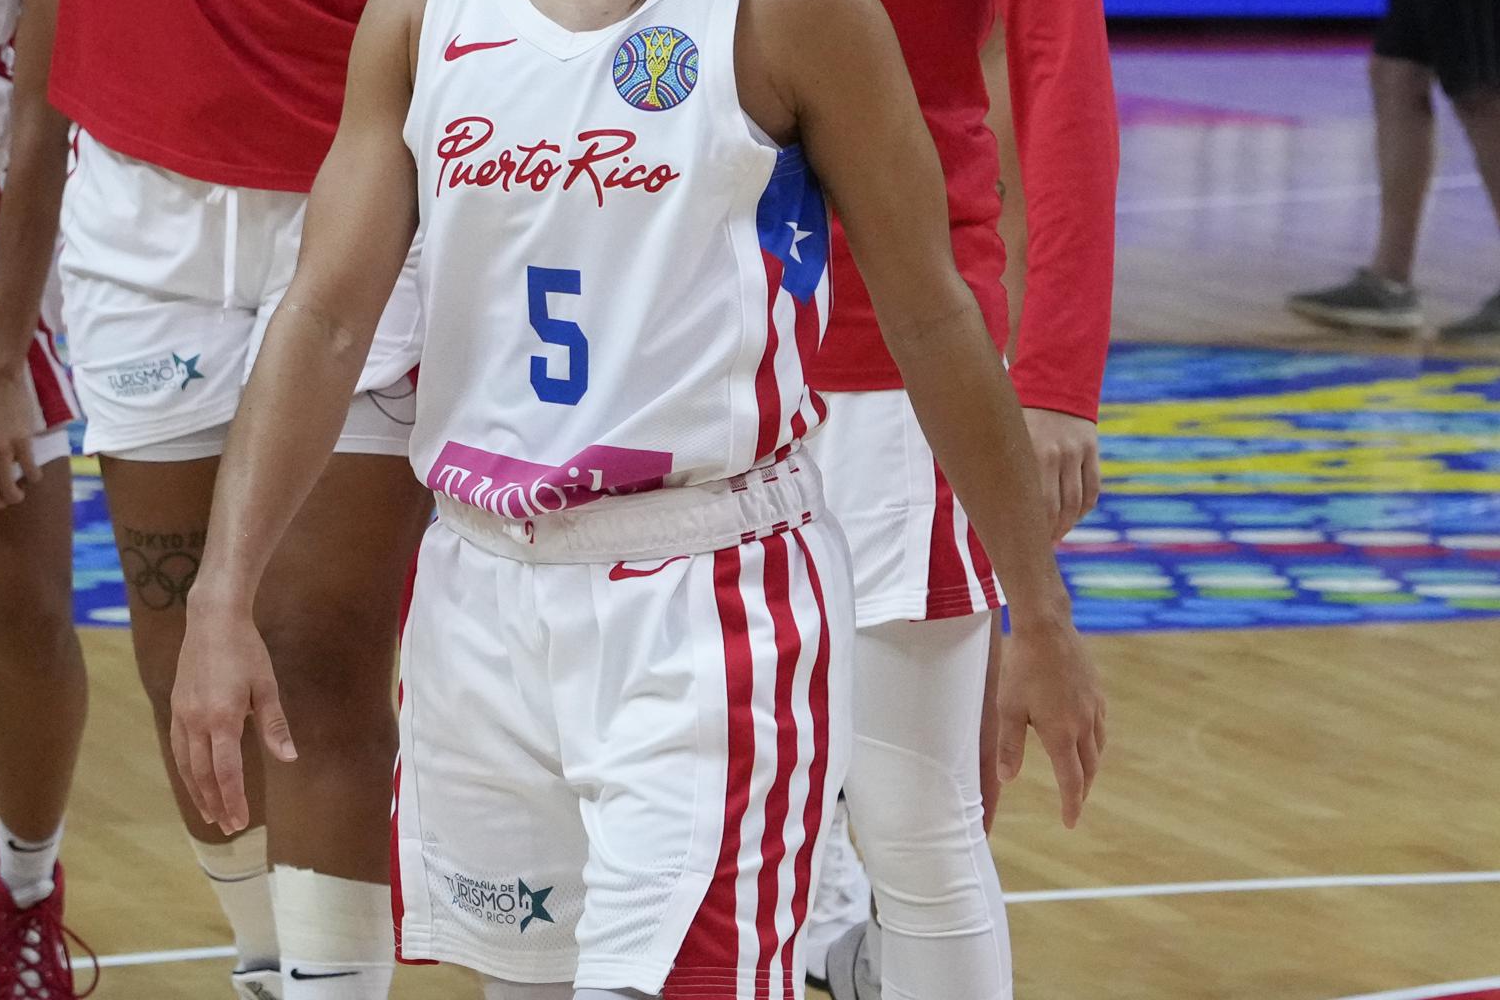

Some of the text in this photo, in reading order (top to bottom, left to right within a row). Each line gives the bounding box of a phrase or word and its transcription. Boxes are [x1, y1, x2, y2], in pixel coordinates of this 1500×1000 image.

[435, 115, 681, 209] Puerto Rico
[526, 264, 589, 407] 5
[443, 874, 516, 913] TURISMO
[500, 884, 515, 893] DE
[486, 911, 517, 925] RICO
